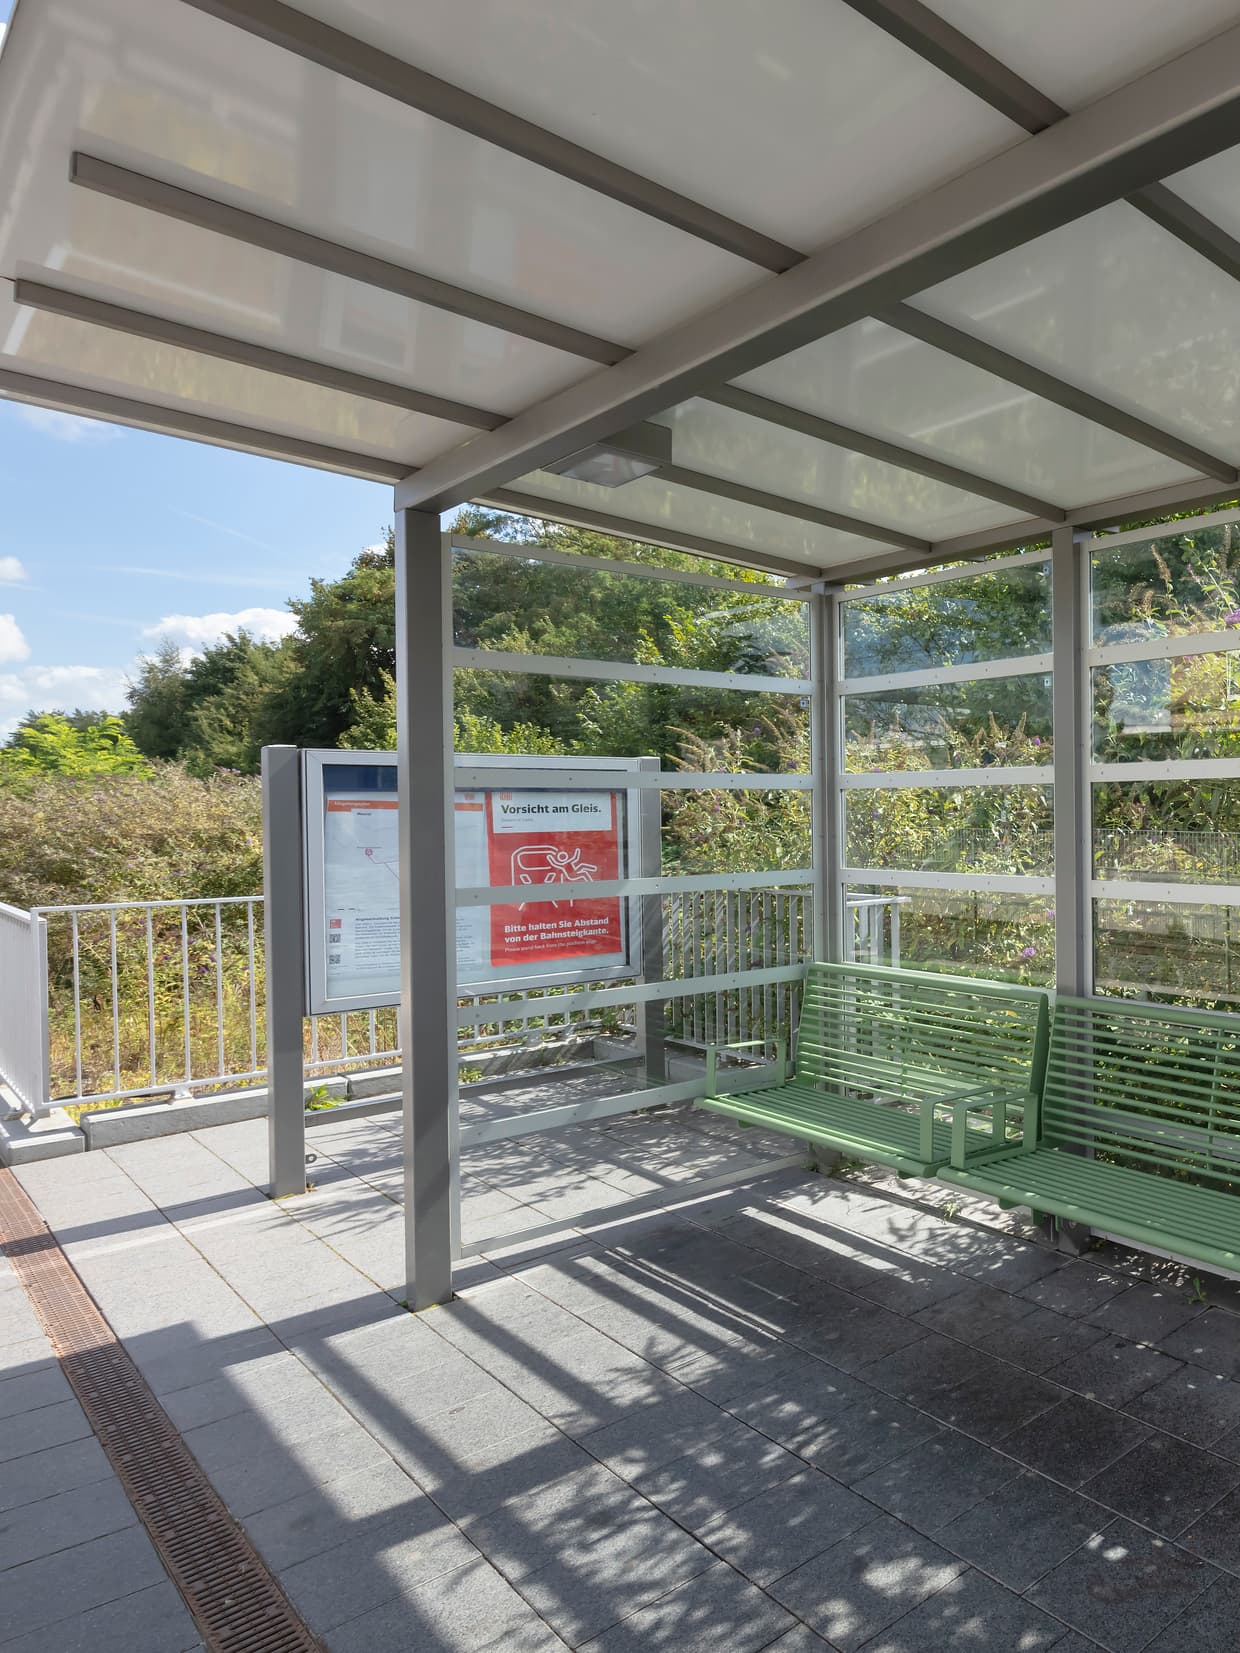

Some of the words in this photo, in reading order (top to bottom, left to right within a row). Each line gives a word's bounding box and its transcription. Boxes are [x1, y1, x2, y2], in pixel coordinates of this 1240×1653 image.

[501, 803, 550, 814] Vorsicht
[552, 806, 569, 814] am
[571, 803, 602, 814] Gleis.
[504, 923, 526, 933] Bitte
[528, 921, 557, 932] halten
[558, 919, 572, 929] Sie
[574, 917, 609, 928] Abstand
[504, 935, 521, 943] von
[523, 932, 538, 941] der
[540, 928, 609, 941] Bahnsteigkante.
